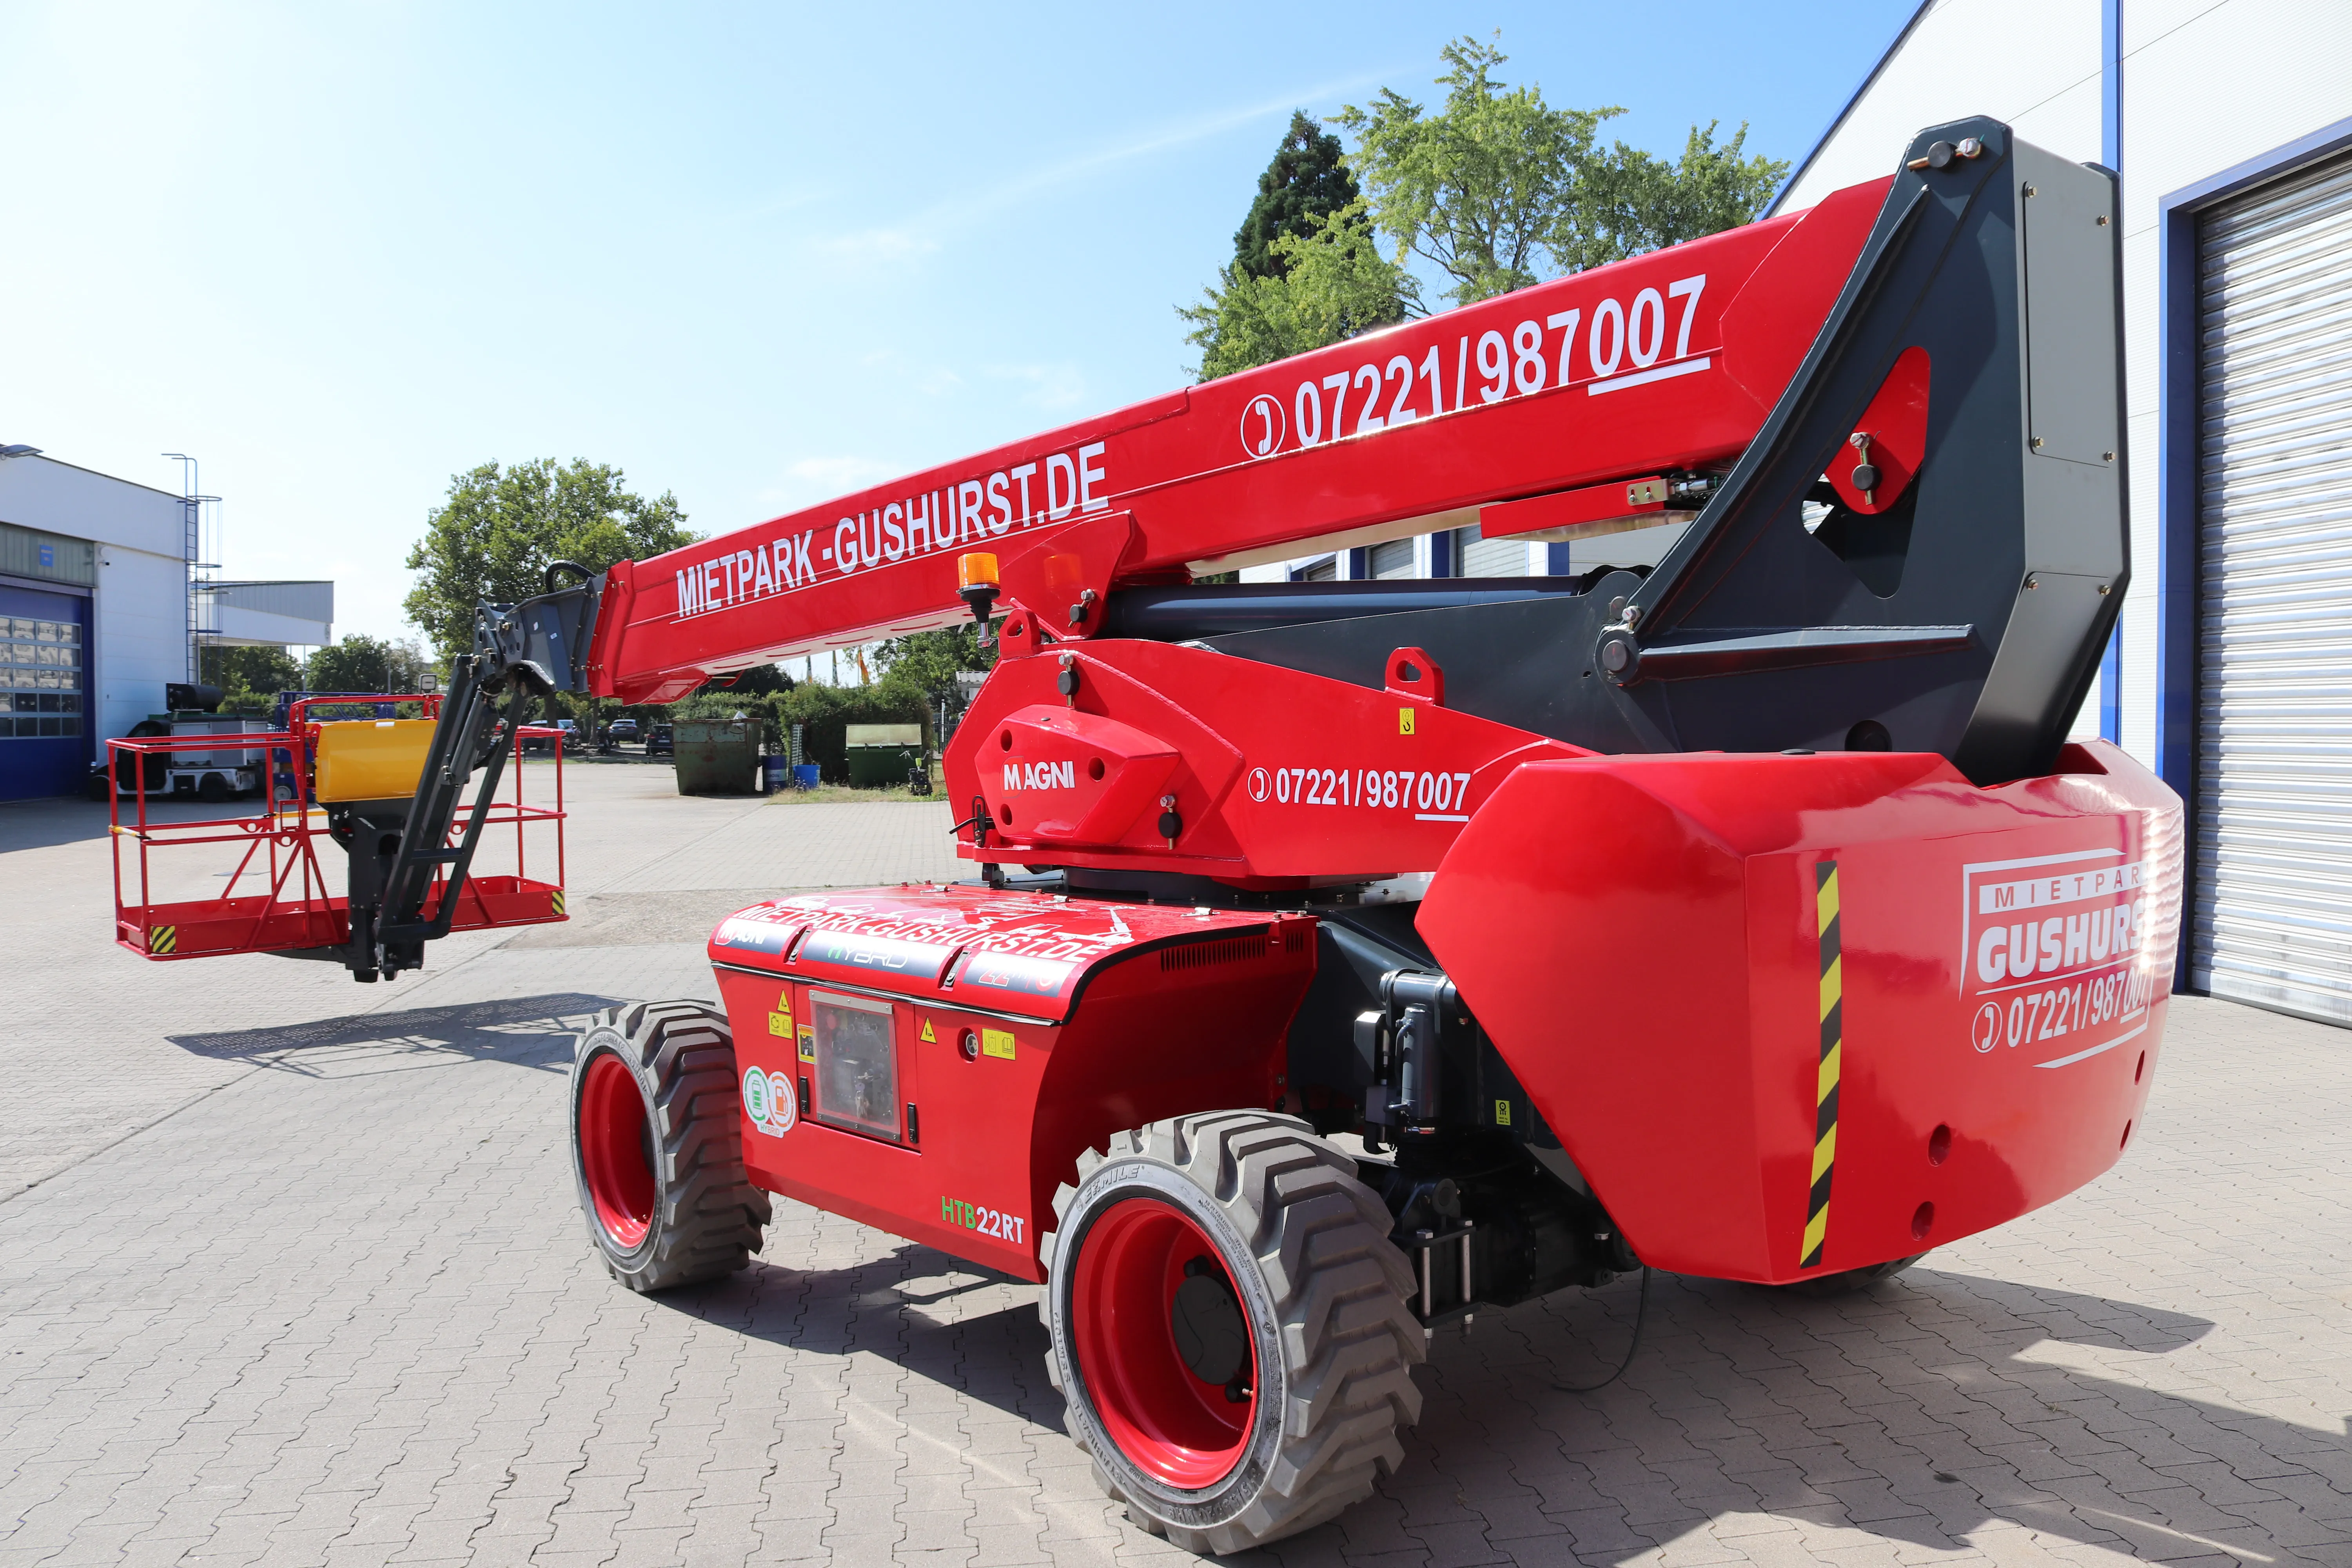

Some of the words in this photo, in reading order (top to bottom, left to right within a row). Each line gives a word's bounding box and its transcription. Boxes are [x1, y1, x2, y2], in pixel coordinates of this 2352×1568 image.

[1295, 274, 1706, 448] 07221/987007
[676, 529, 817, 618] MIETPARK
[1004, 760, 1075, 790] MAGNI
[1276, 768, 1471, 811] 07221/987007
[1995, 864, 2151, 908] MIETPAR
[720, 927, 767, 944] MAGNI
[733, 905, 1112, 963] MIETPARK-GUSHURST.DE
[1977, 898, 2152, 983] GUSHURS
[760, 1124, 780, 1136] HYBRID
[941, 1195, 1024, 1244] HTB22RT
